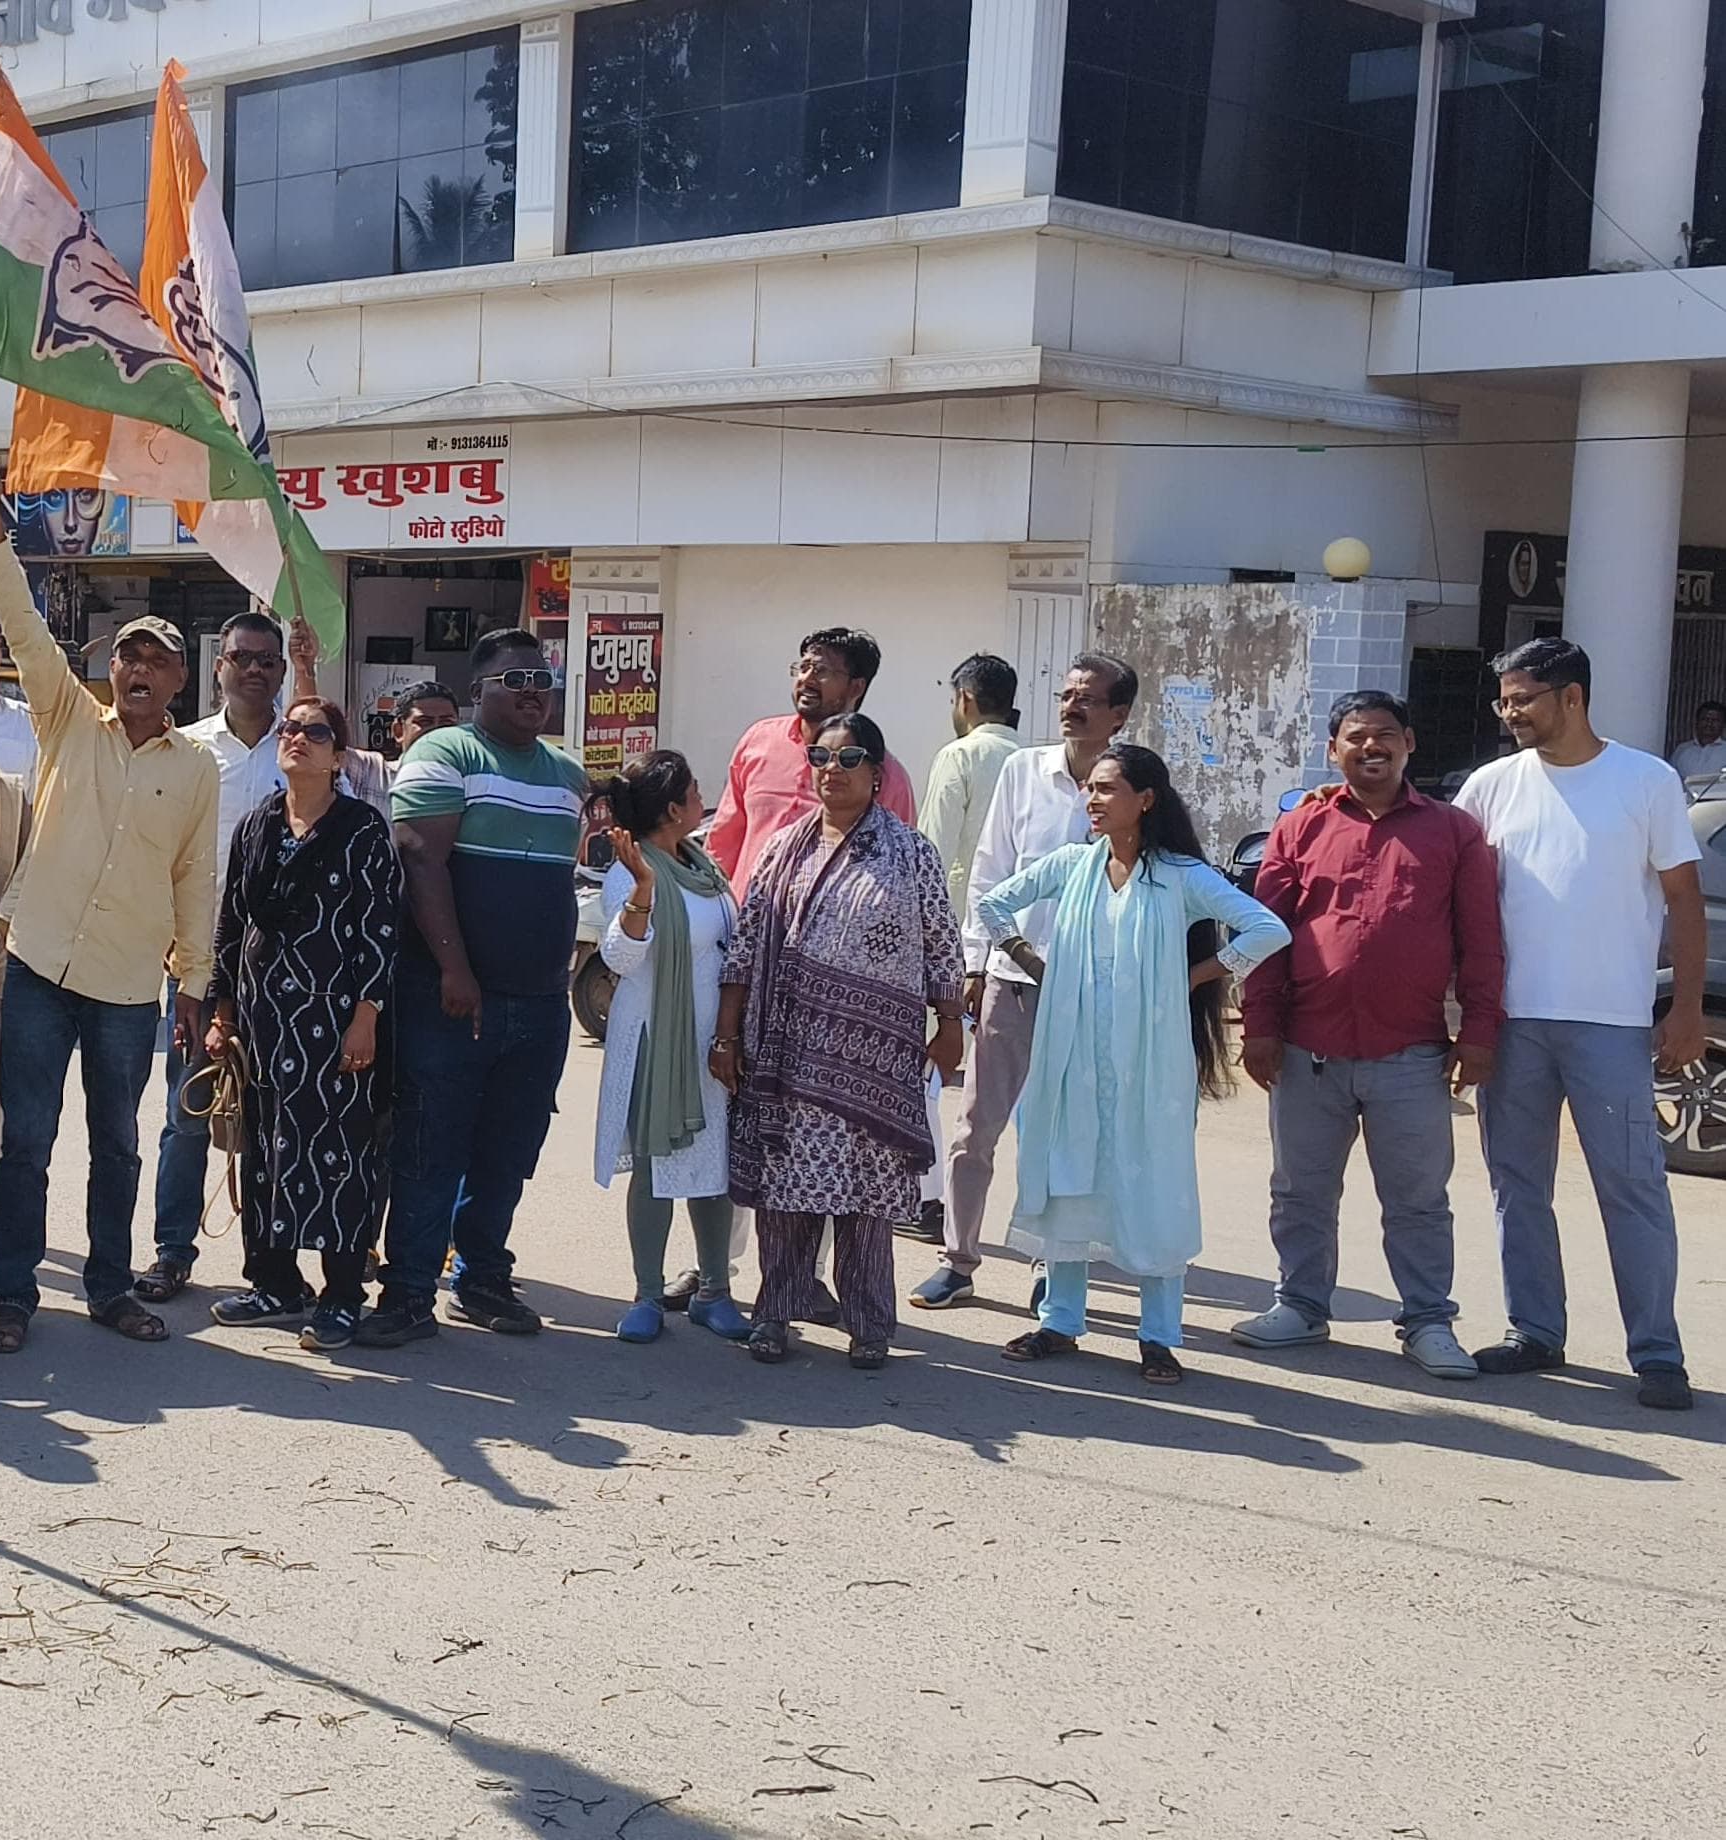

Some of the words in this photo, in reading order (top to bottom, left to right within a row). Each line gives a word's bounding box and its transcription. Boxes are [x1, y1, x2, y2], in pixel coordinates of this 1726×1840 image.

[451, 434, 509, 451] 9131364115
[336, 458, 505, 508] खुशबु
[409, 516, 446, 539] फोटो
[590, 634, 657, 685] खुशबू
[589, 688, 616, 716] फोटो
[619, 685, 657, 722] स्टूडियो
